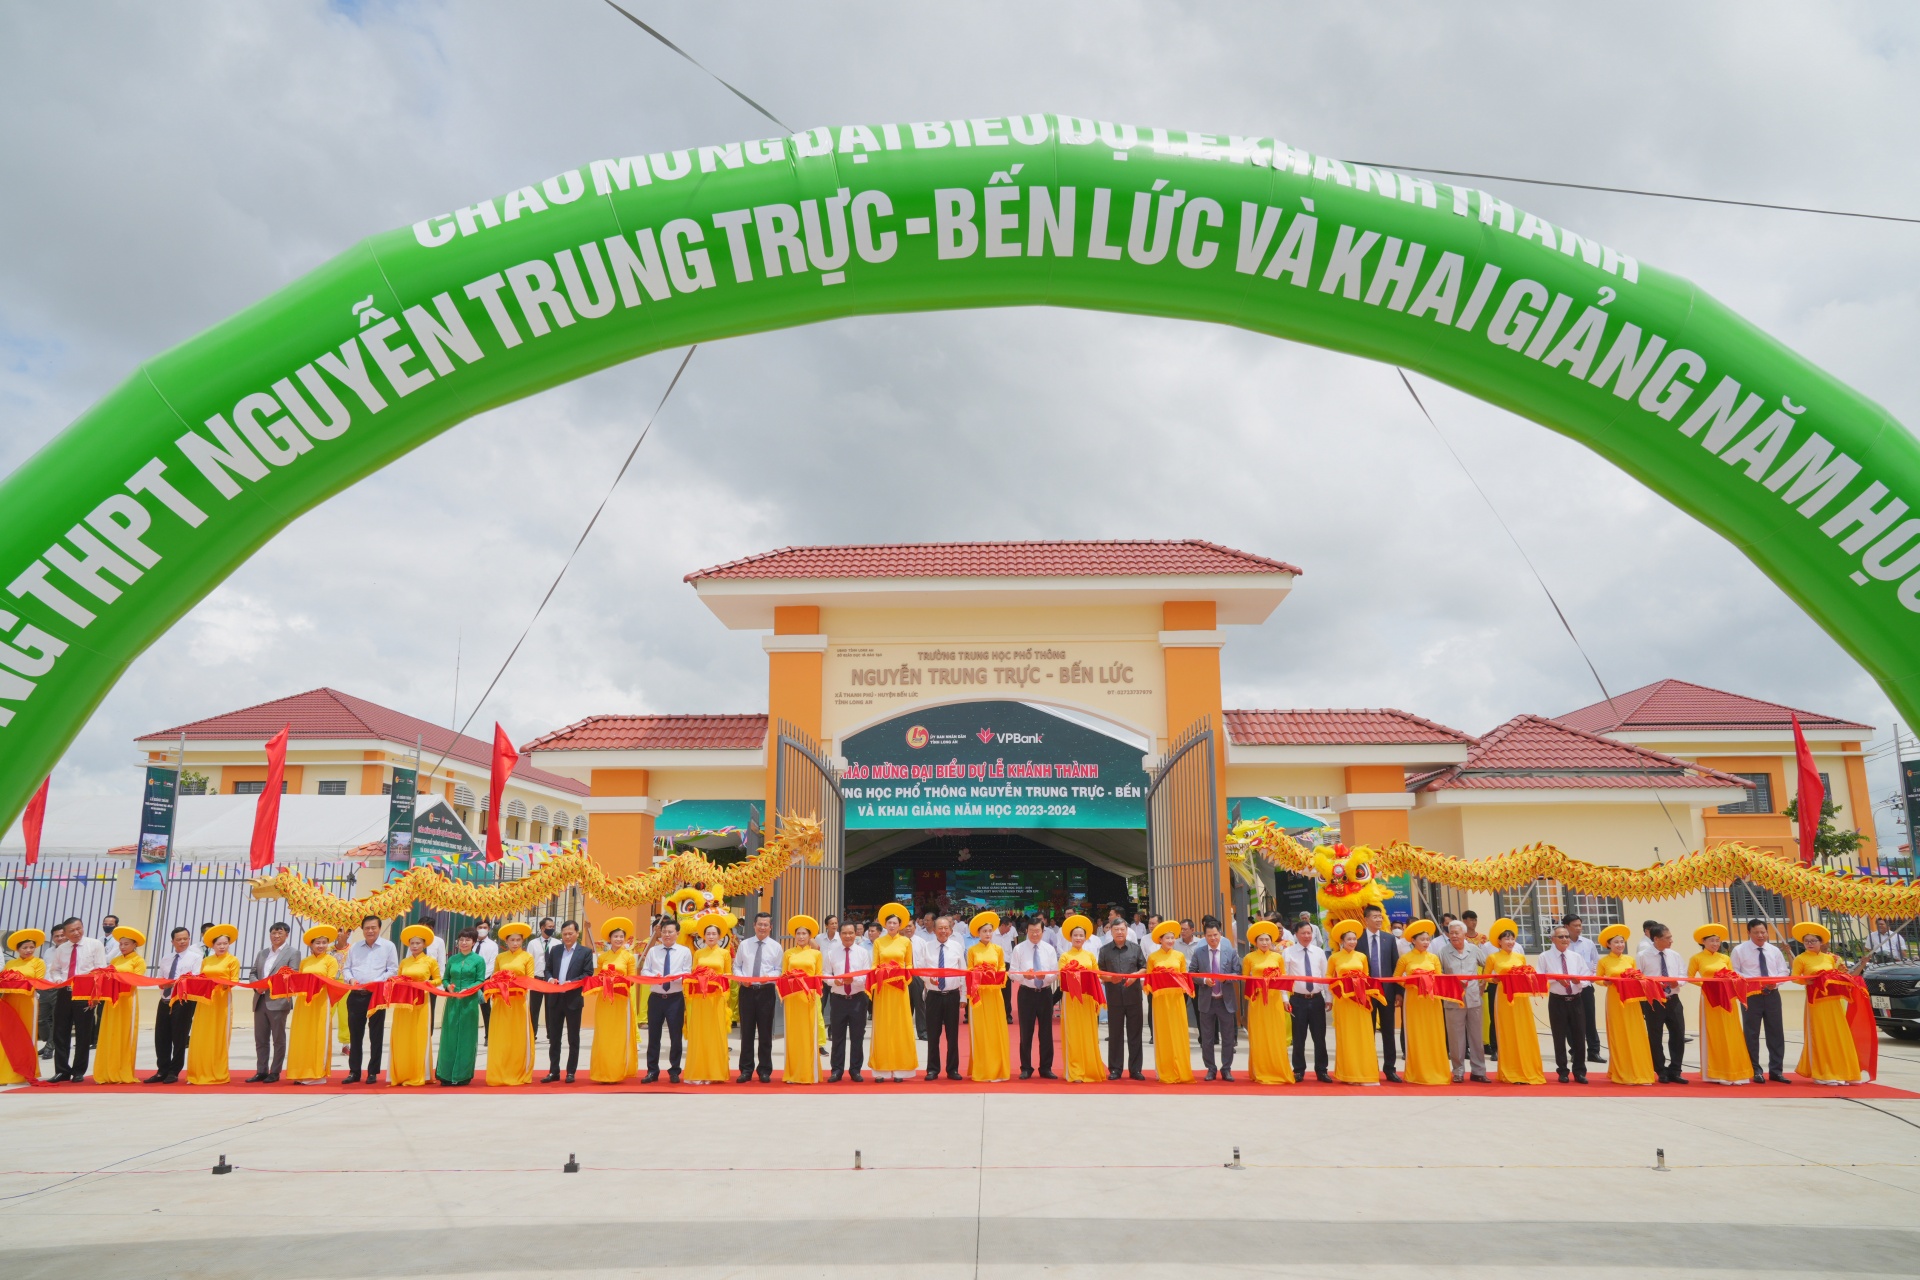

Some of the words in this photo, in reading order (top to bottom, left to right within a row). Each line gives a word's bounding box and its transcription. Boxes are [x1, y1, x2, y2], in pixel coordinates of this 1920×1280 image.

[5, 456, 209, 629] THPT
[174, 291, 486, 501] NGUYỄN
[463, 217, 717, 350] TRUNG
[1087, 178, 1224, 270] LỨC
[1235, 196, 1319, 289] VÀ
[1319, 224, 1502, 332] KHAI
[1486, 278, 1707, 422] GIẢNG
[1677, 374, 1863, 520] NĂM
[918, 649, 956, 660] TRƯỜNG
[958, 651, 990, 660] TRUNG
[991, 650, 1011, 662] HỌC
[1013, 648, 1032, 660] PHỔ
[1034, 649, 1066, 660] THÔNG
[851, 663, 922, 686] NGUYỄN
[928, 667, 988, 685] TRUNG
[993, 664, 1041, 688] TRỰC
[1059, 660, 1094, 684] BẾN
[1099, 660, 1134, 684] LỨC
[996, 733, 1042, 744] VPBank
[841, 762, 869, 779] HÀO
[872, 762, 908, 779] MỪNG
[911, 764, 933, 782] ĐẠI
[936, 758, 966, 778] BIỂU
[968, 762, 987, 782] DỰ
[988, 758, 1004, 778] LỄ
[1007, 760, 1052, 778] KHÁNH
[1054, 760, 1099, 778] THÀNH
[842, 787, 862, 798] NG
[866, 788, 892, 801] HỌC
[895, 782, 920, 798] PHỔ
[924, 784, 967, 798] THÔNG
[970, 782, 1022, 798] NGUYỄN
[1026, 786, 1068, 798] TRUNG
[1071, 784, 1105, 800] TRỰC
[1115, 782, 1141, 798] BẾN
[858, 803, 874, 816] VÀ
[878, 806, 908, 816] KHAI
[912, 802, 951, 816] GIẢNG
[954, 802, 982, 816] NĂM
[986, 805, 1012, 818] HỌC
[1015, 804, 1076, 816] 2023-2024
